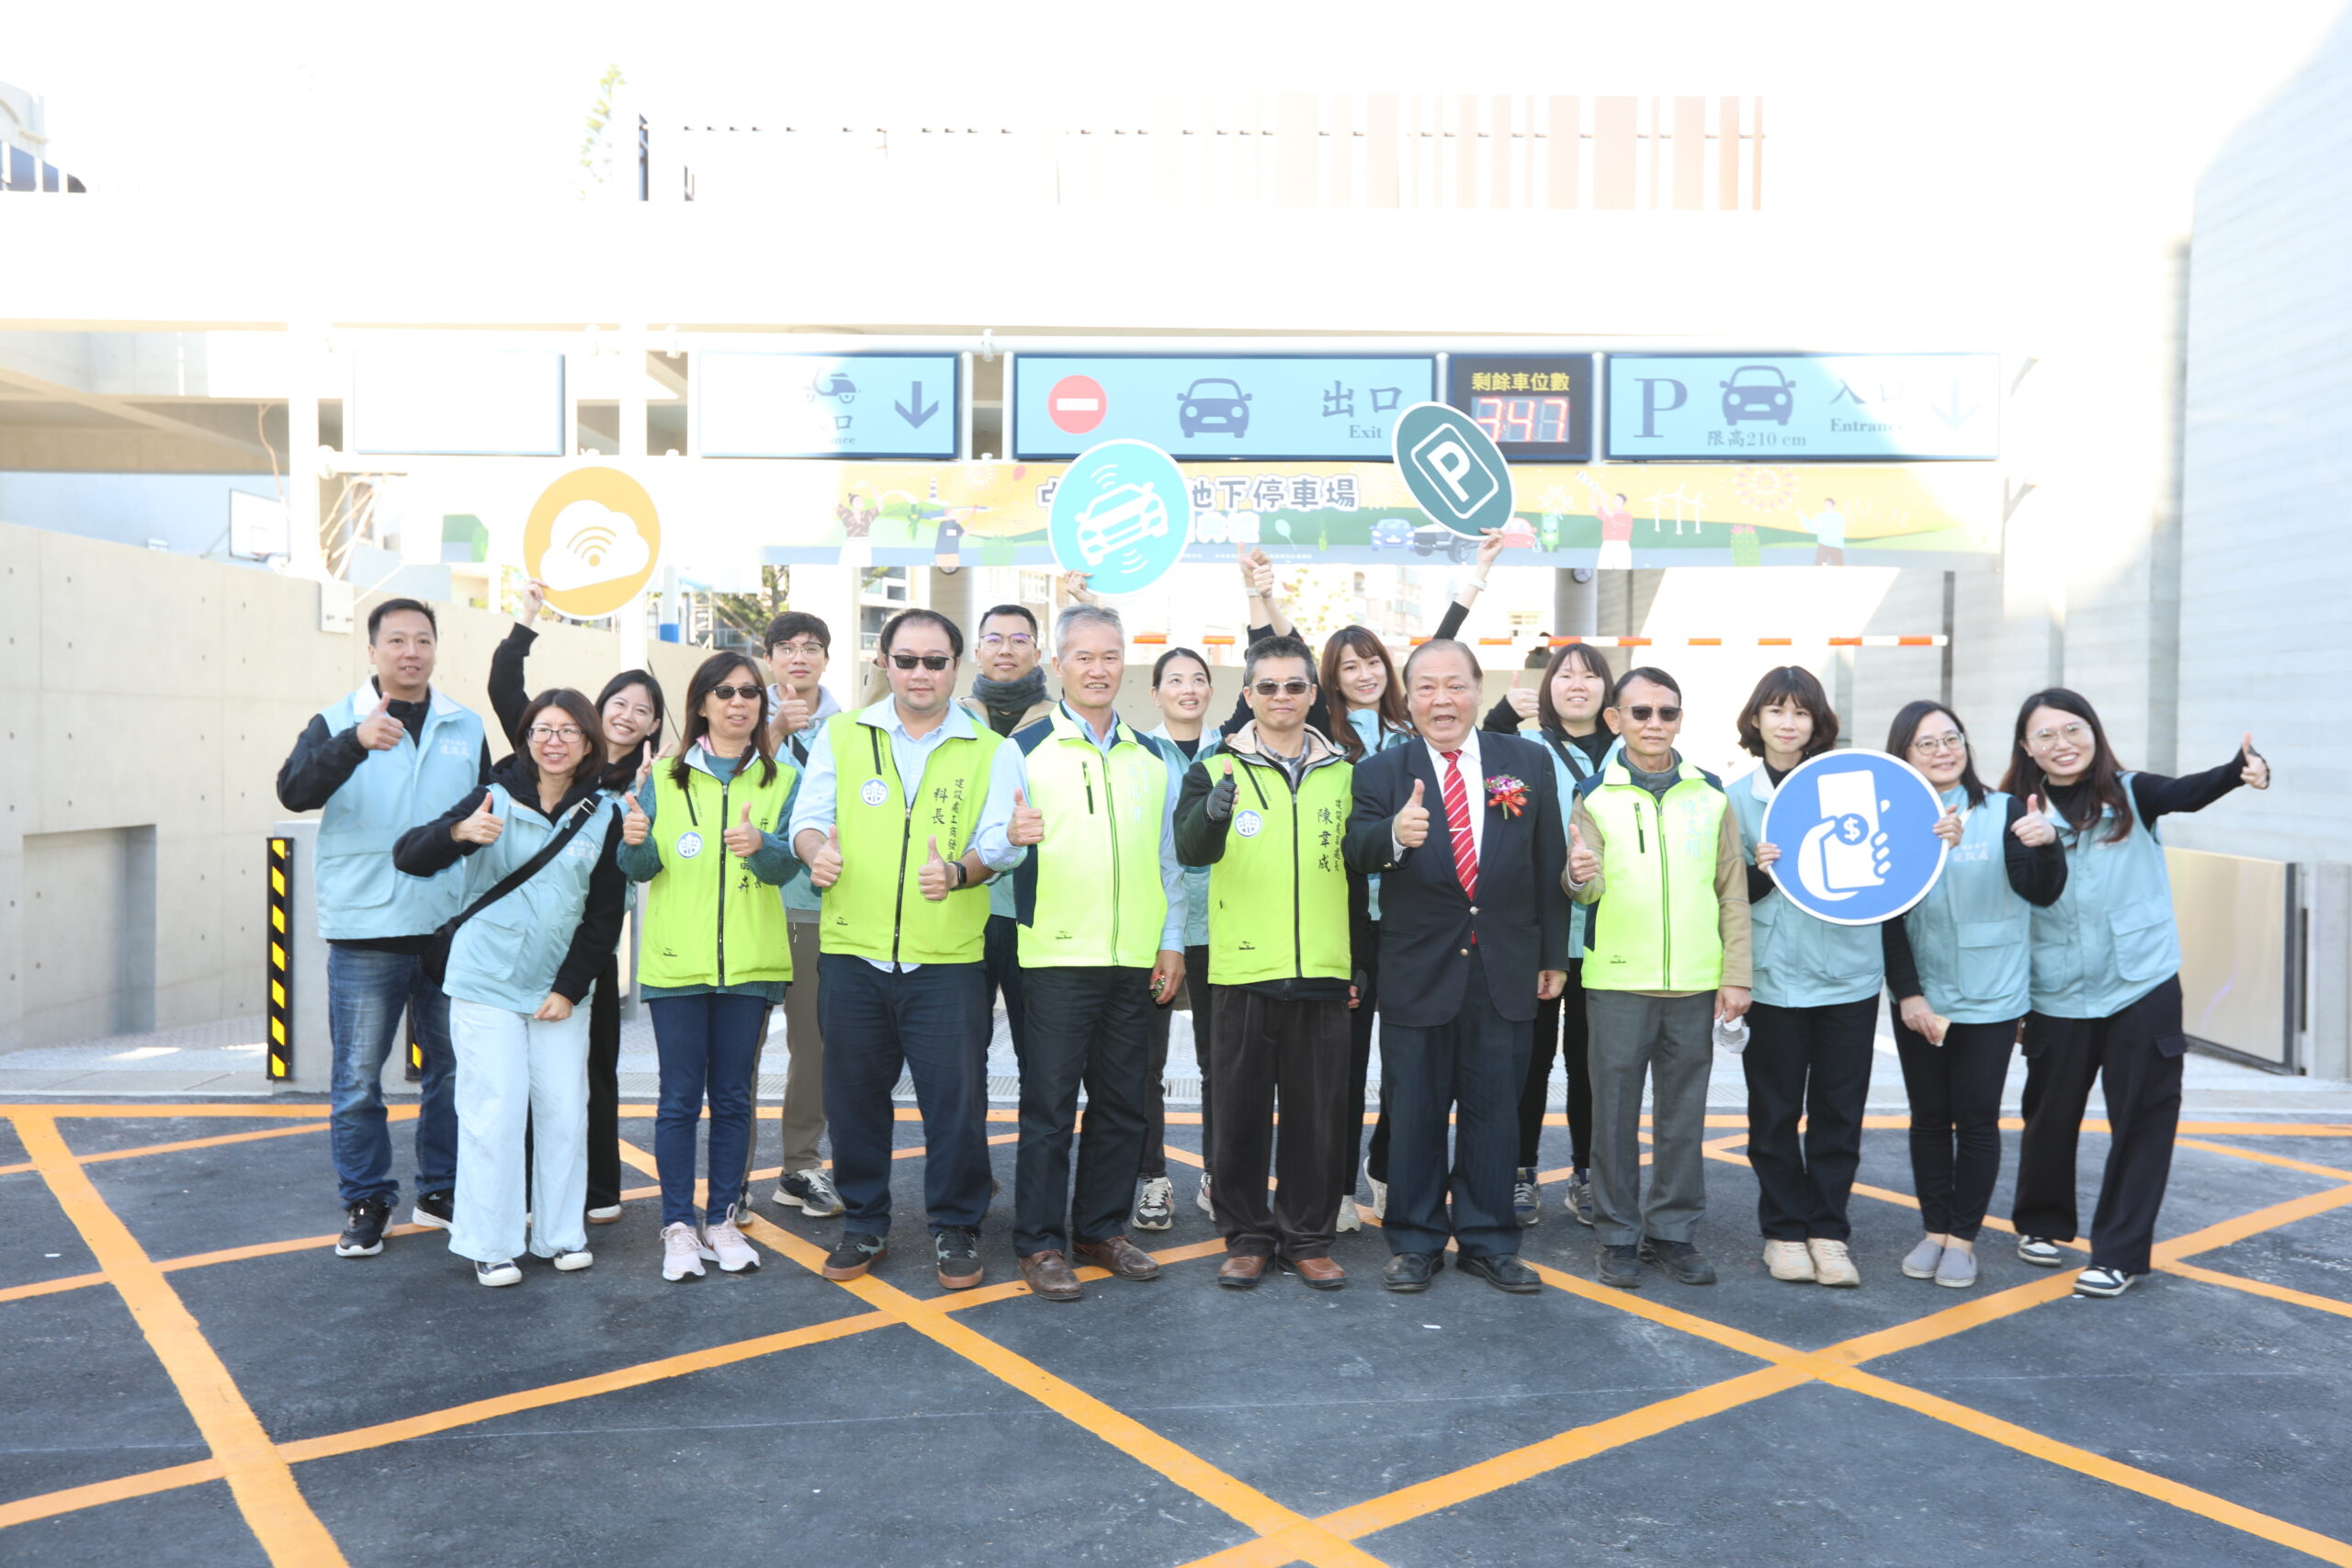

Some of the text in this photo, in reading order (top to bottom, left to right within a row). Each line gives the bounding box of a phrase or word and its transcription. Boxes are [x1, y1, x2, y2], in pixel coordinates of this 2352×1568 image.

[1320, 379, 1404, 418] 出口
[1471, 371, 1570, 392] 剩餘車位數
[1475, 397, 1570, 444] 347
[1634, 378, 1688, 438] P
[1348, 424, 1383, 439] Exit
[1781, 434, 1807, 447] cm
[931, 787, 948, 825] 科長
